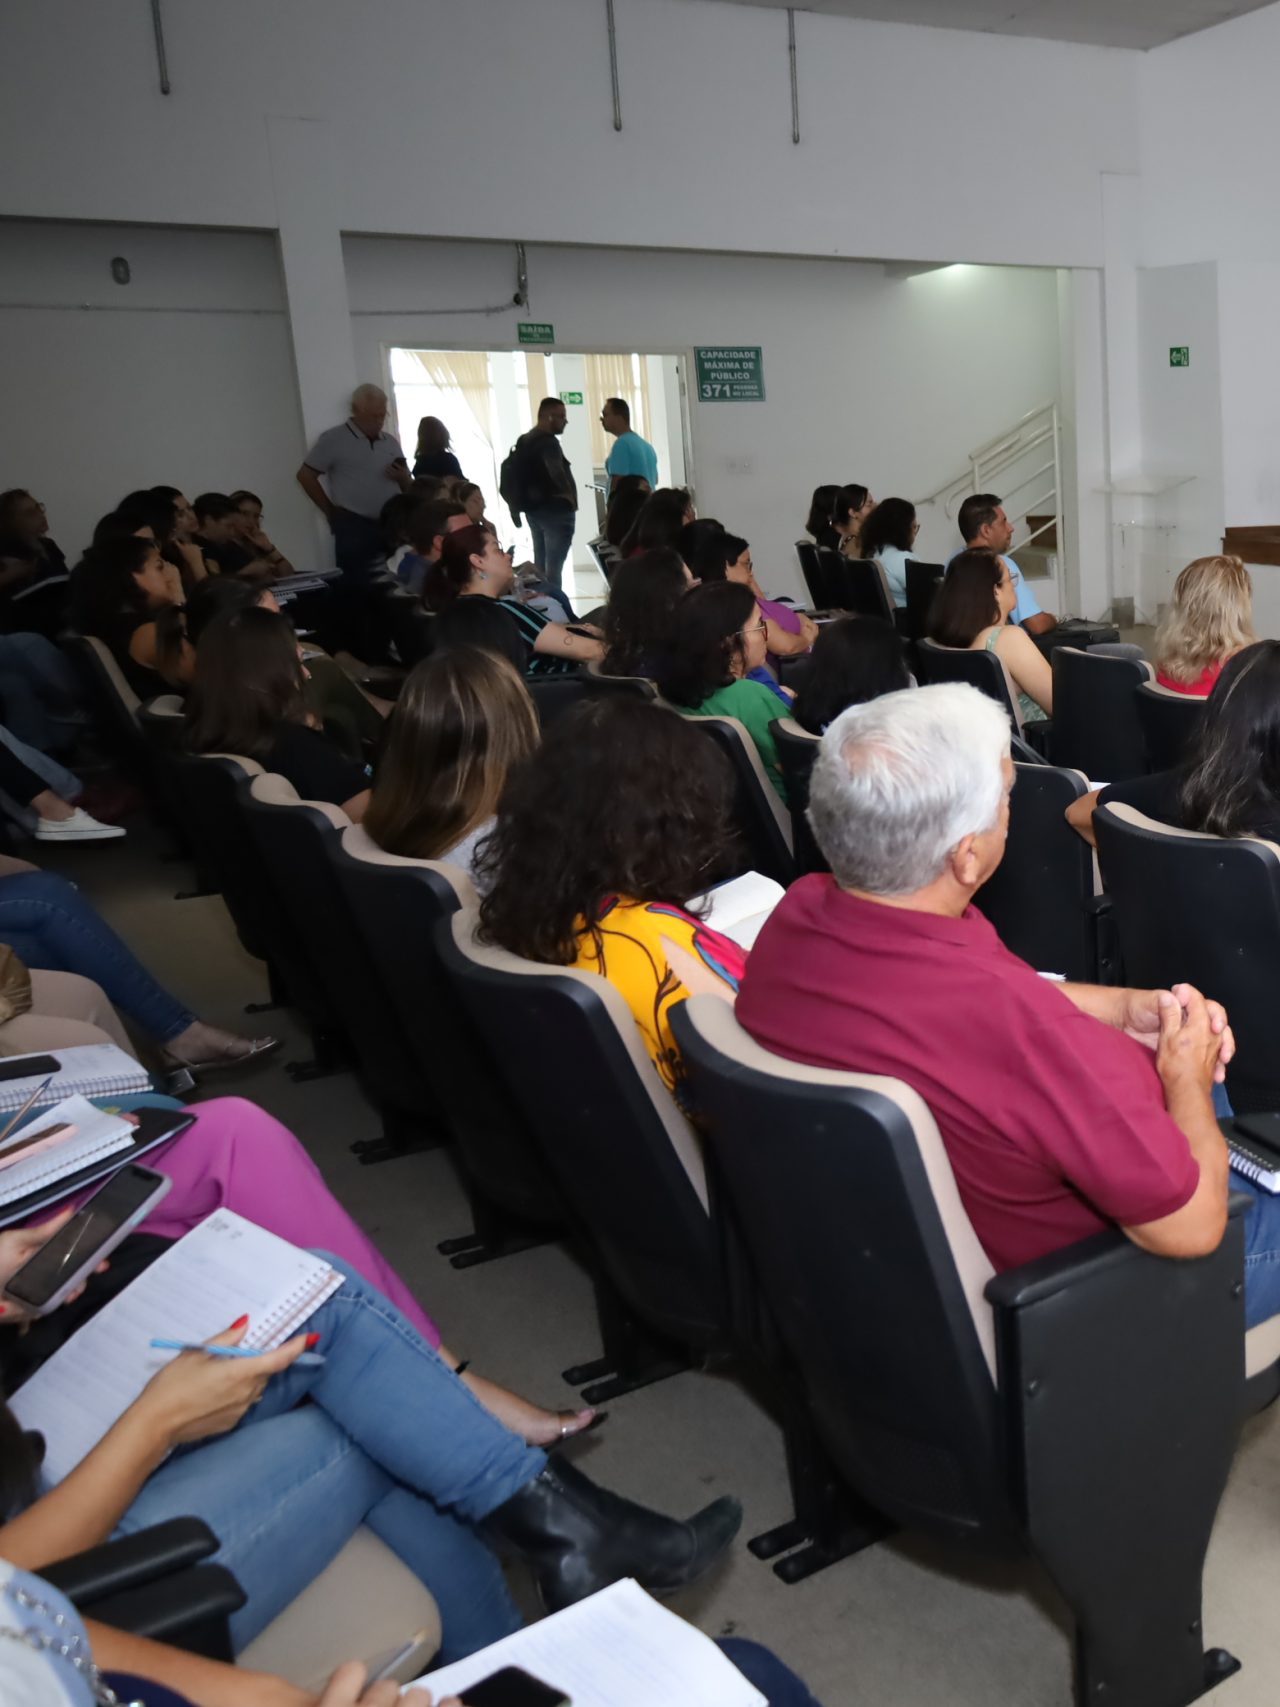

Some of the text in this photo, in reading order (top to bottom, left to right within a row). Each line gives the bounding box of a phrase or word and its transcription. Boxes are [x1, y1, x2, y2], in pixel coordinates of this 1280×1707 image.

[700, 351, 756, 359] CAPACIDADE
[704, 360, 754, 369] MÁXIMA DE
[710, 371, 750, 380] PÚBLICO
[702, 384, 731, 397] 371
